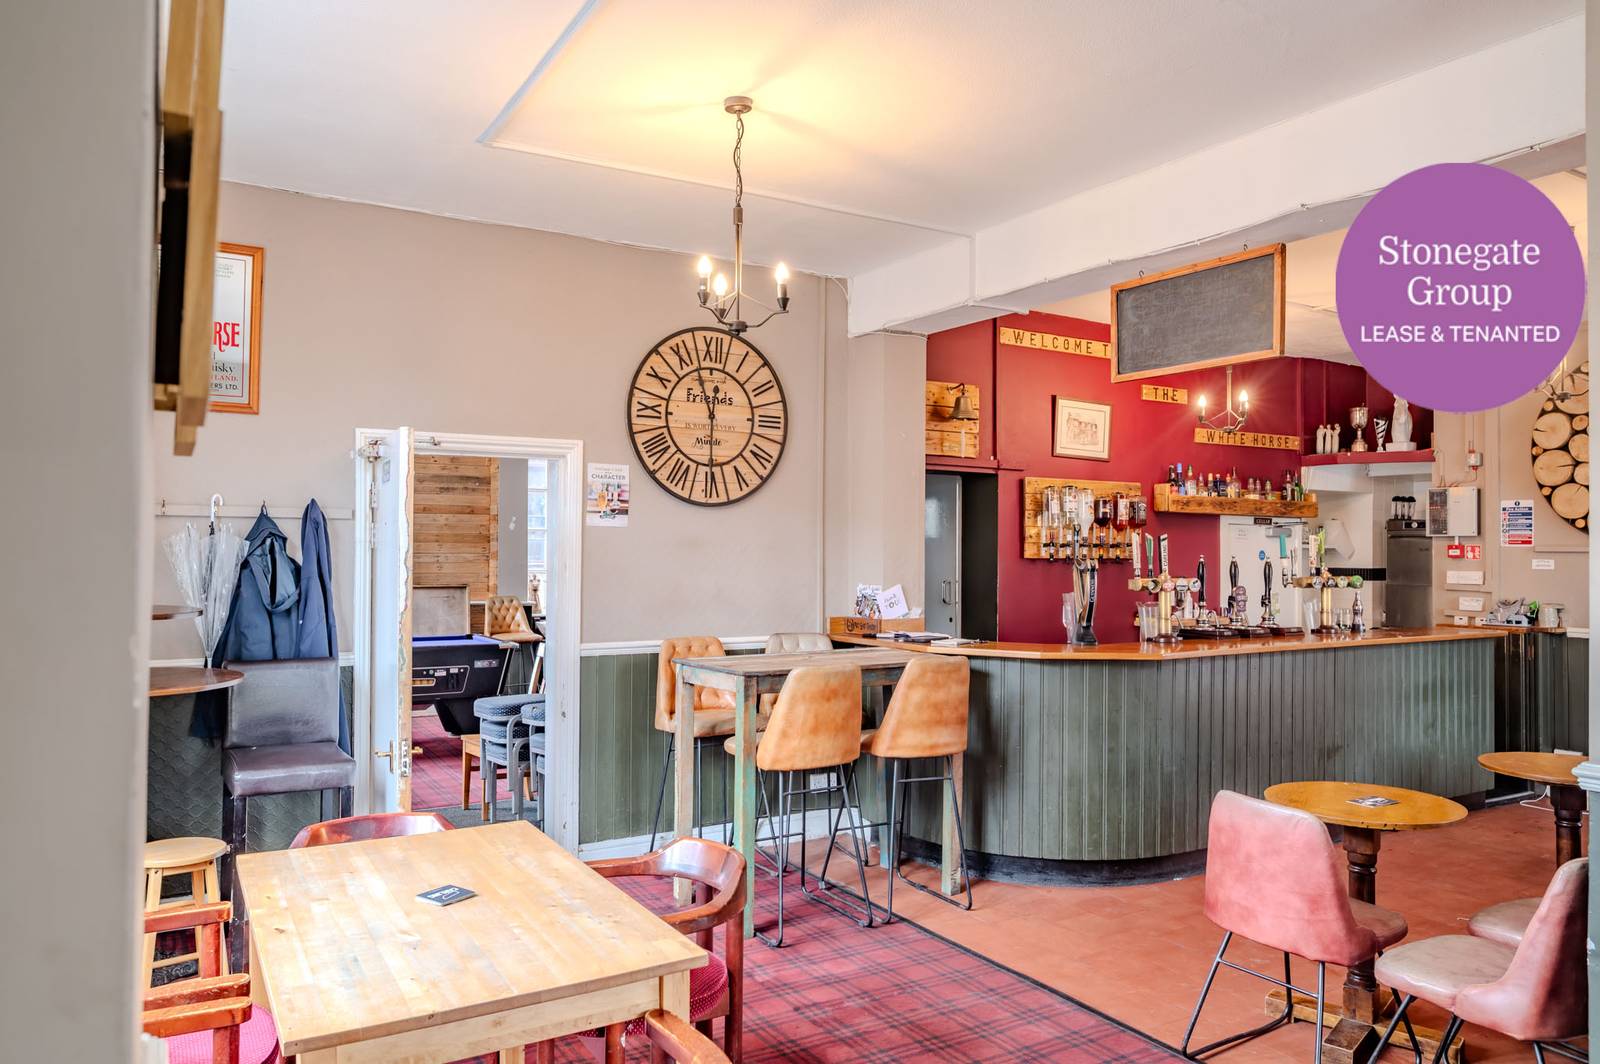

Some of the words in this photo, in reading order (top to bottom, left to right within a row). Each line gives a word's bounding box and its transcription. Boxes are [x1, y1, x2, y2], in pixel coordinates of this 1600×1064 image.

[213, 321, 240, 352] RSE
[1013, 329, 1093, 354] WELCOME
[1102, 343, 1109, 357] T
[212, 362, 233, 375] isky
[686, 388, 734, 406] Friends
[1152, 387, 1179, 402] THE
[1206, 430, 1246, 445] WHITE
[1253, 433, 1290, 449] HORSE
